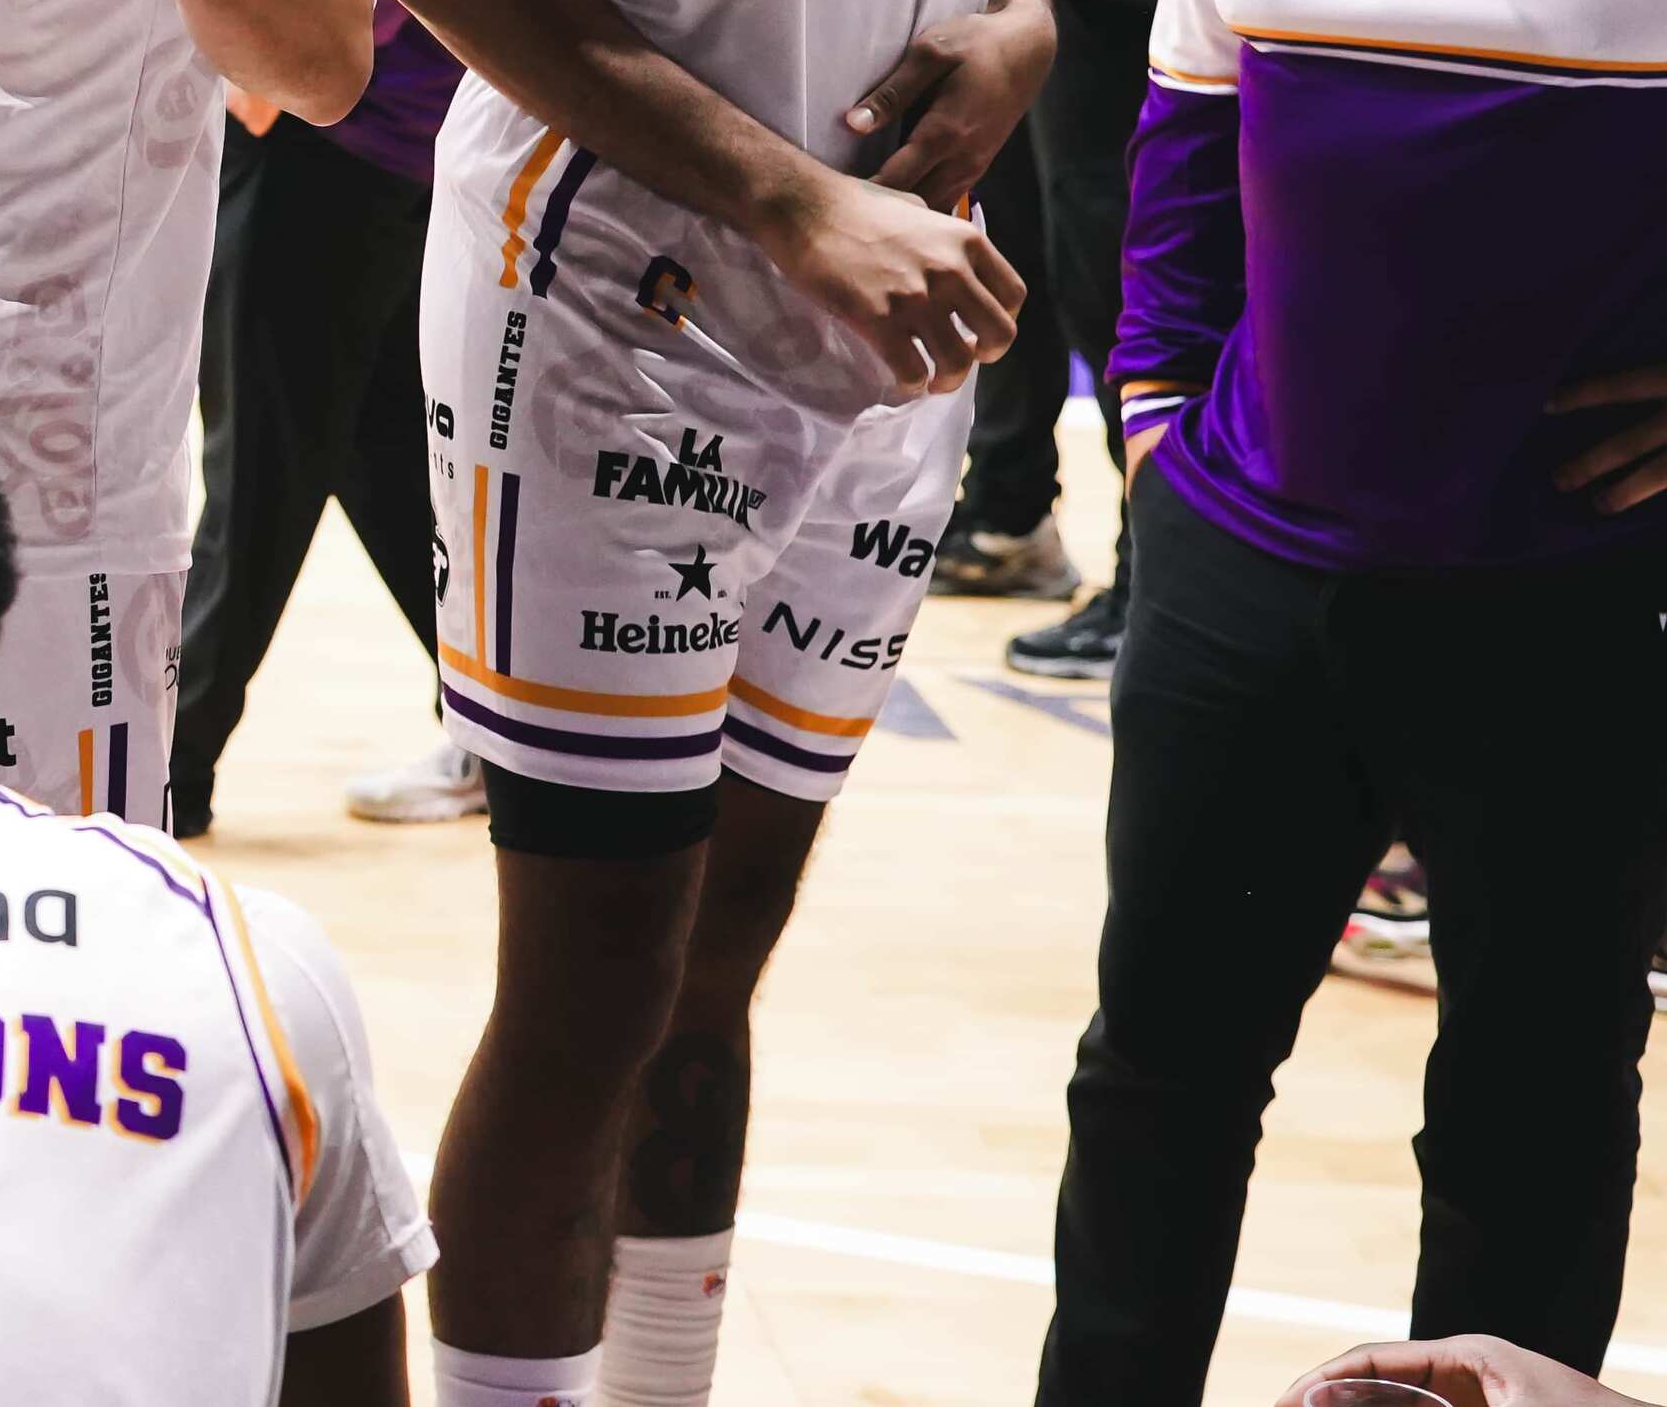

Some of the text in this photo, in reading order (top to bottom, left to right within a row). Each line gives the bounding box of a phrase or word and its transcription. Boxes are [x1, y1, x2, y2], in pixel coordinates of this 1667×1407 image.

[489, 310, 528, 451] GIGANTES
[678, 427, 724, 473] LA
[593, 450, 752, 532] FAMILIA
[579, 610, 739, 654] Heineke
[762, 601, 908, 670] NISS
